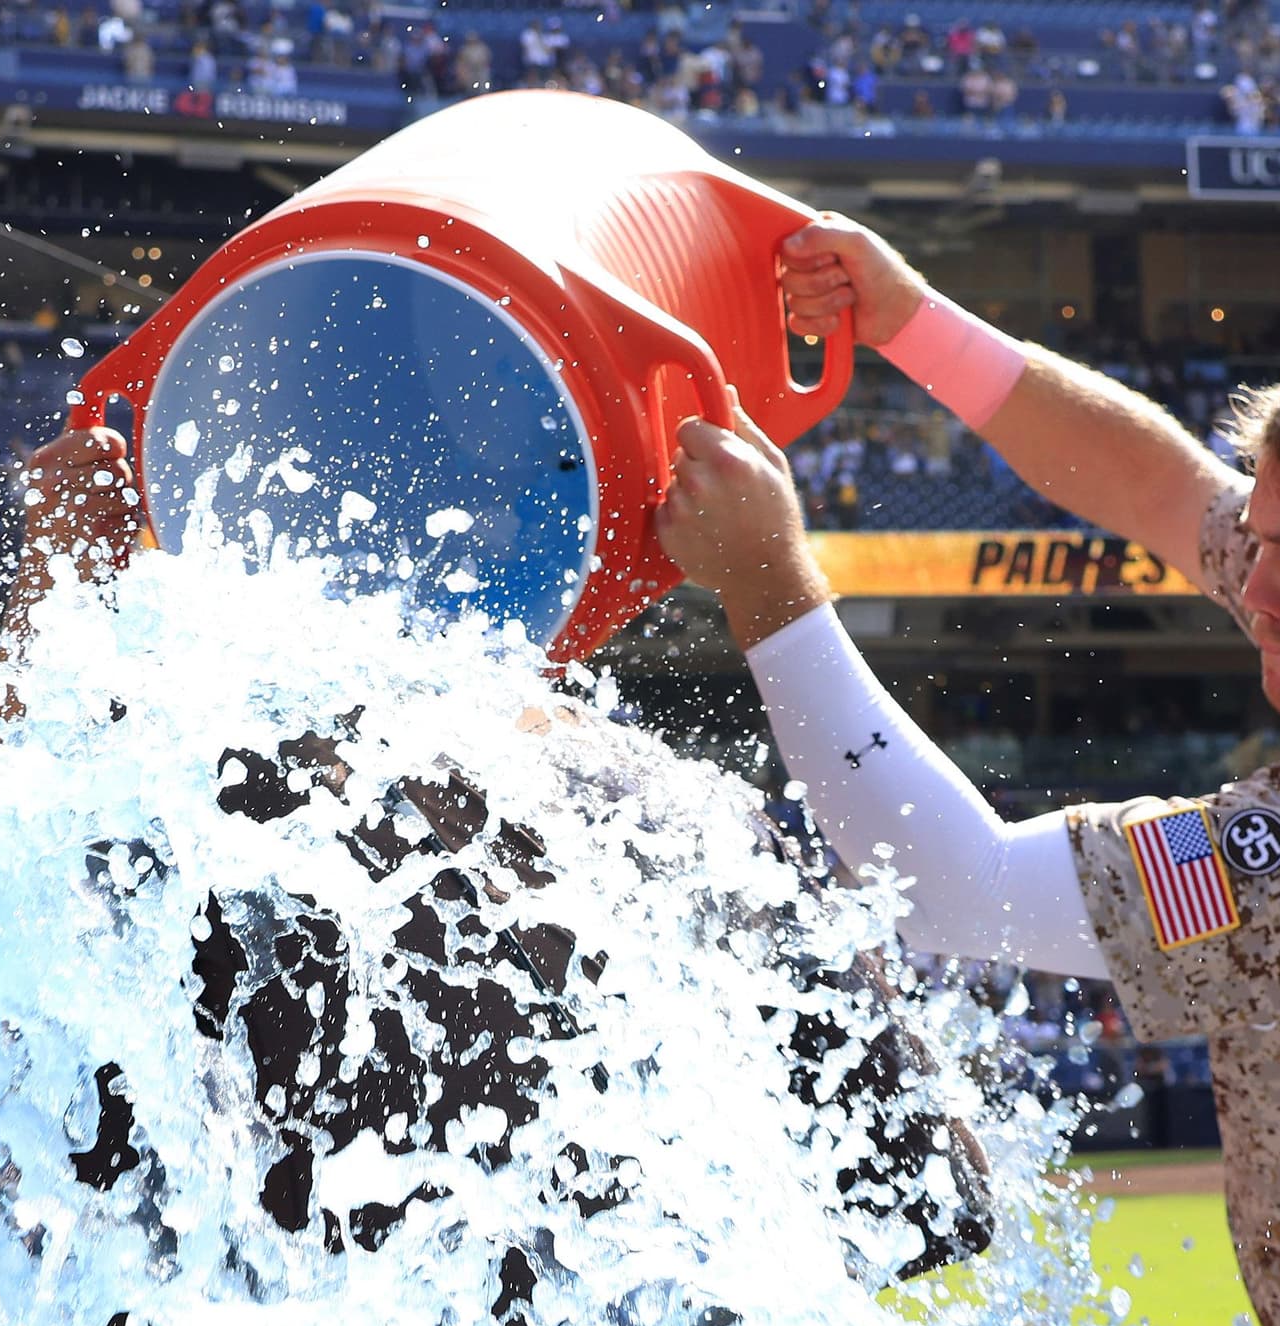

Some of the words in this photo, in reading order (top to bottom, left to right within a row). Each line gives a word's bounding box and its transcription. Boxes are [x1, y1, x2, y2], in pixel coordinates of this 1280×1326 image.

[78, 85, 169, 114] JACKIE
[216, 95, 347, 125] ROBINSON
[972, 540, 1166, 586] PADS
